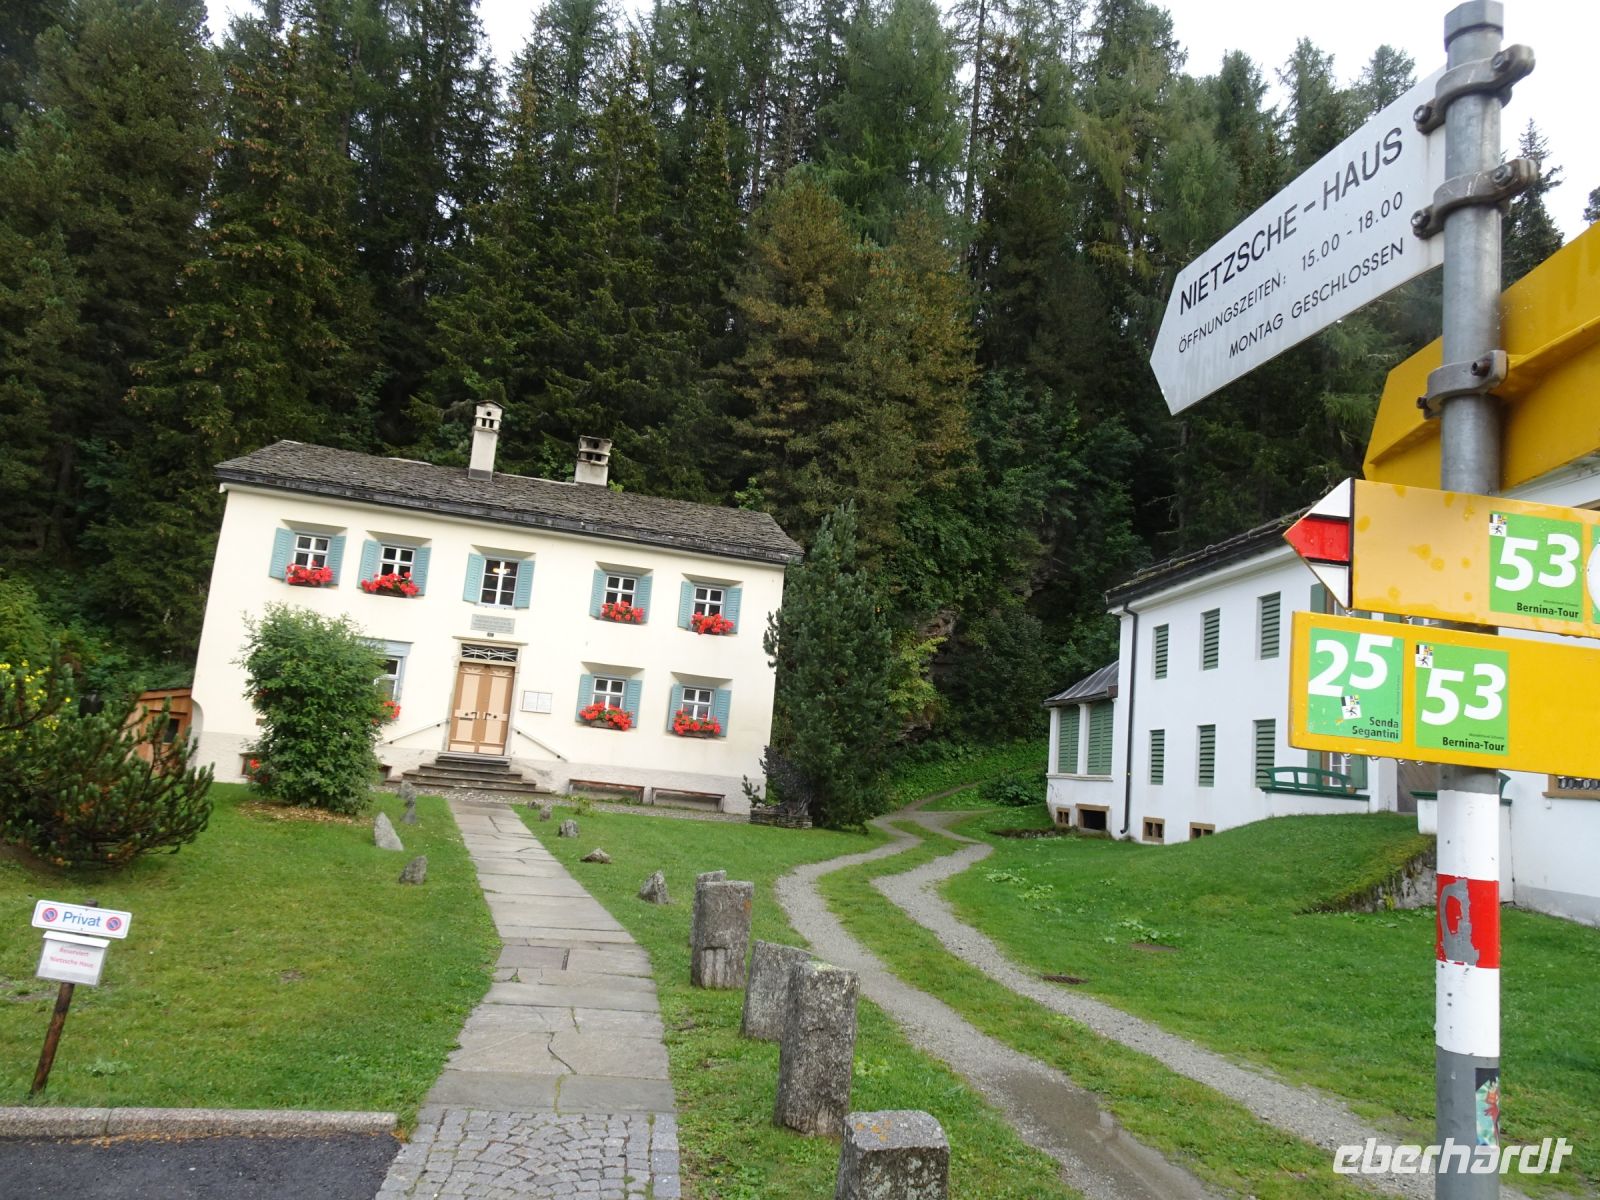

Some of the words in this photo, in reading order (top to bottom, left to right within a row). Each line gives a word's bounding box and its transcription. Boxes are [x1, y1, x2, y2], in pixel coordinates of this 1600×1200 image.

[1178, 272, 1287, 353] ÖFFNUNGSZEITEN:
[1301, 233, 1340, 271] 15.00
[1358, 191, 1403, 234] 18.00
[1229, 313, 1284, 358] MONTAG
[1291, 237, 1404, 319] GESCHLOSSEN
[1495, 533, 1580, 592] 53
[1516, 602, 1579, 618] Bernina-Tour
[1308, 633, 1394, 698] 25
[1421, 663, 1506, 726] 53
[1352, 725, 1399, 739] Segantini
[1369, 716, 1399, 728] Senda
[1442, 736, 1504, 751] Bernina-Tour
[62, 911, 102, 927] Privat
